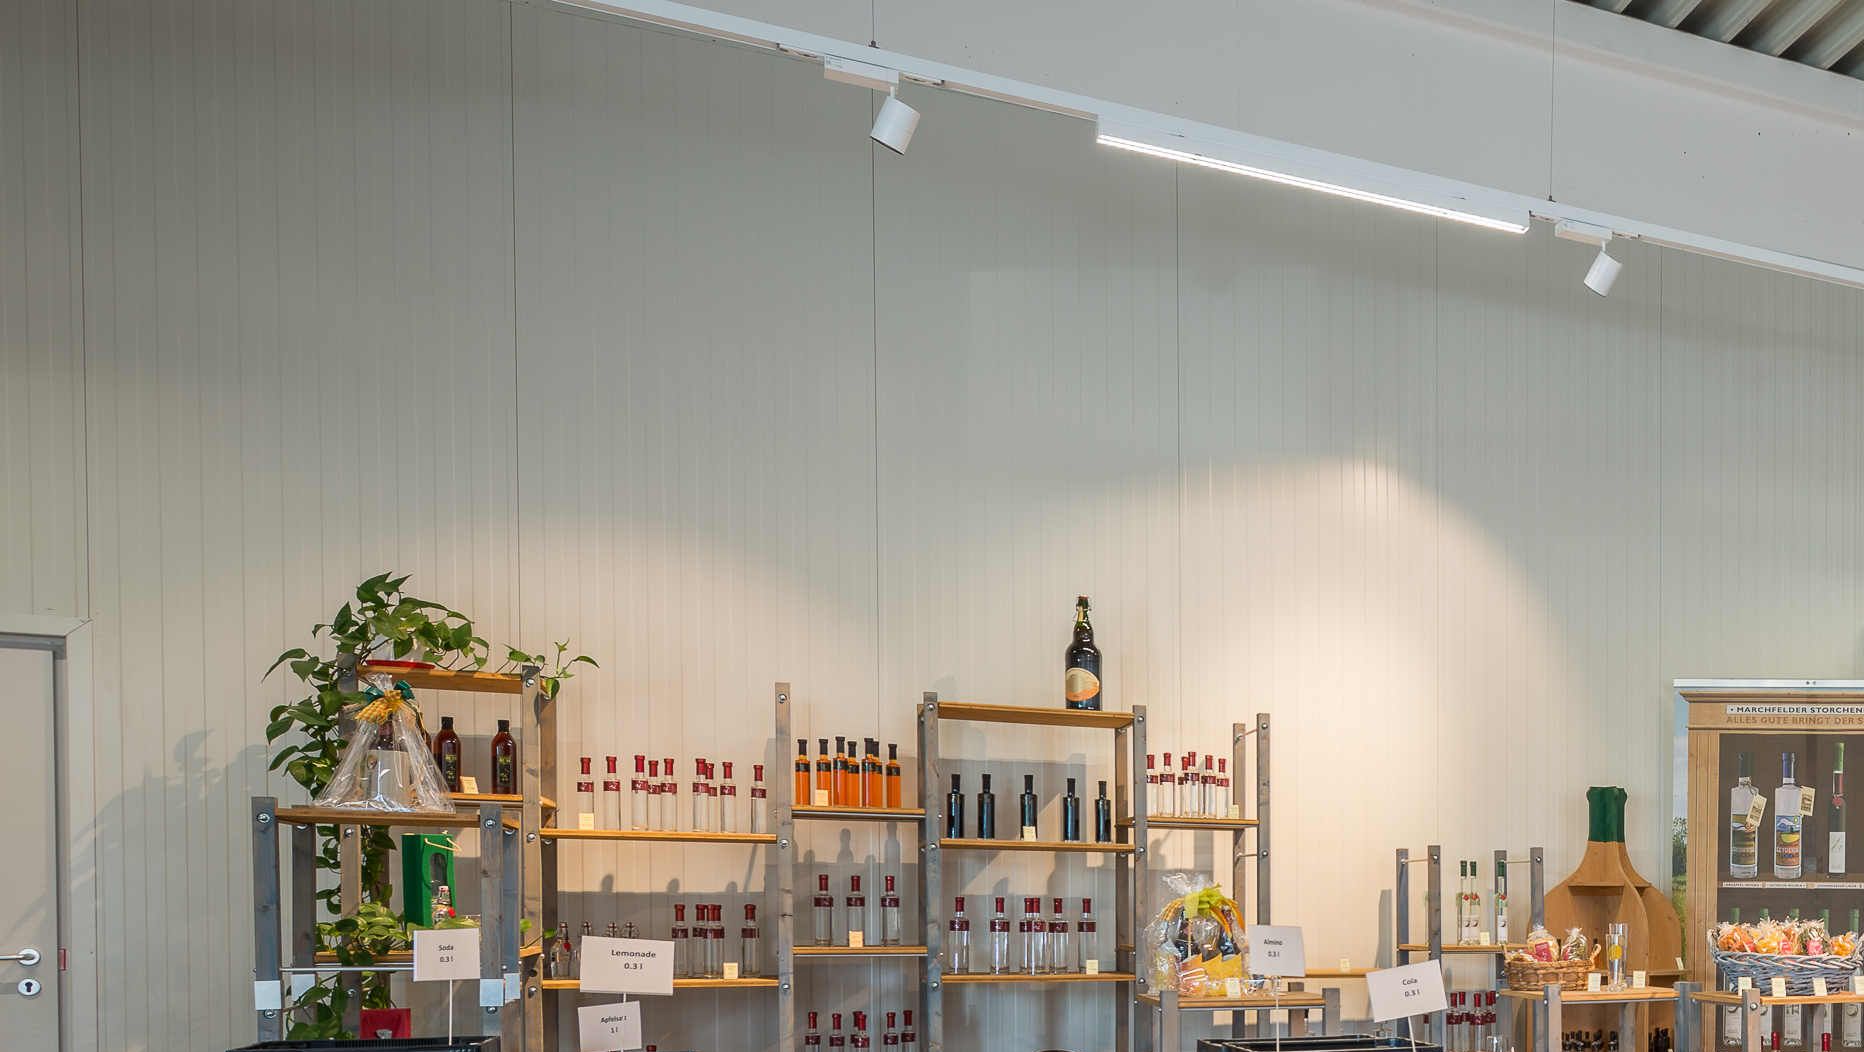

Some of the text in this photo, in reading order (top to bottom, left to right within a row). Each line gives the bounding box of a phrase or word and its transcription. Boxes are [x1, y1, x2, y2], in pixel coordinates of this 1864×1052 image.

[1736, 706, 1808, 714] MARCHFELDER
[1726, 716, 1757, 725] ALLES
[1761, 716, 1788, 725] GUTE
[1792, 716, 1831, 725] BRINGT
[1834, 716, 1854, 725] DER
[438, 943, 454, 952] Soda
[611, 949, 656, 958] Lemonade
